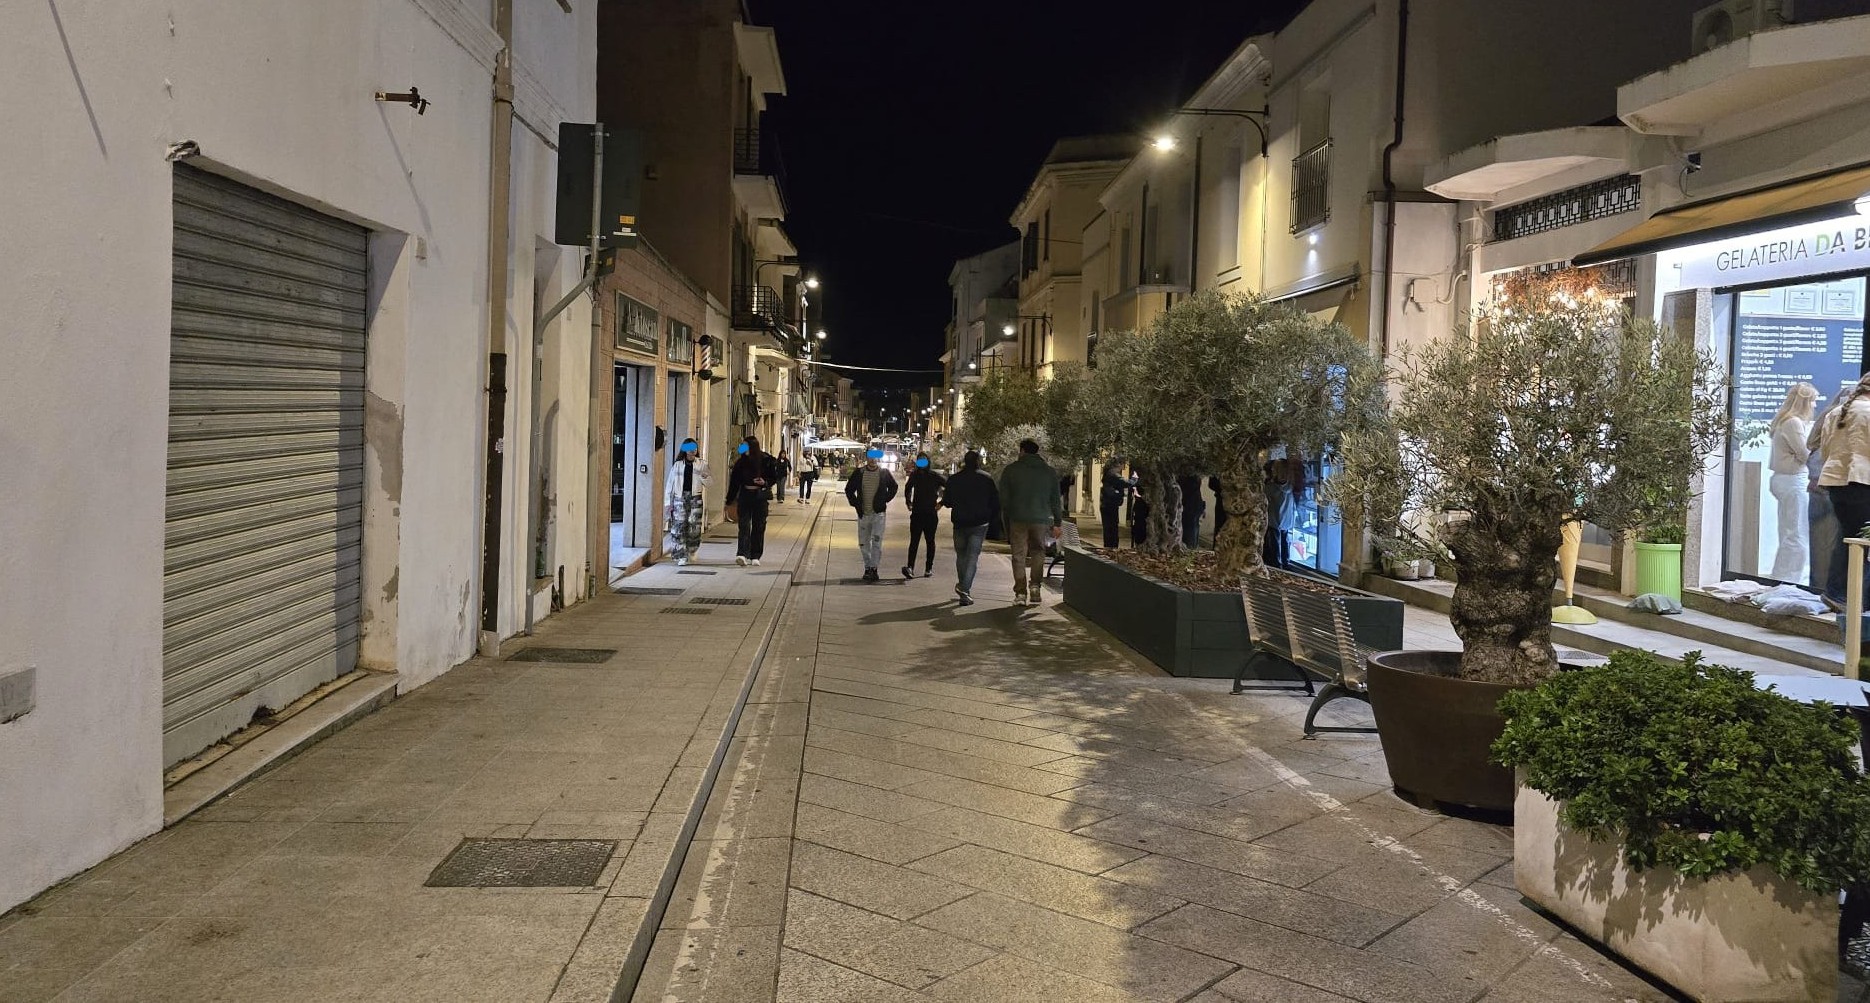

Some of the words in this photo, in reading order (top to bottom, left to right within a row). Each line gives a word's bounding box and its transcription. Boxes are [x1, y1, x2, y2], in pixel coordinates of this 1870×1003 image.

[1717, 238, 1808, 271] GELATERIA
[1815, 231, 1846, 256] DA
[1854, 225, 1870, 250] B
